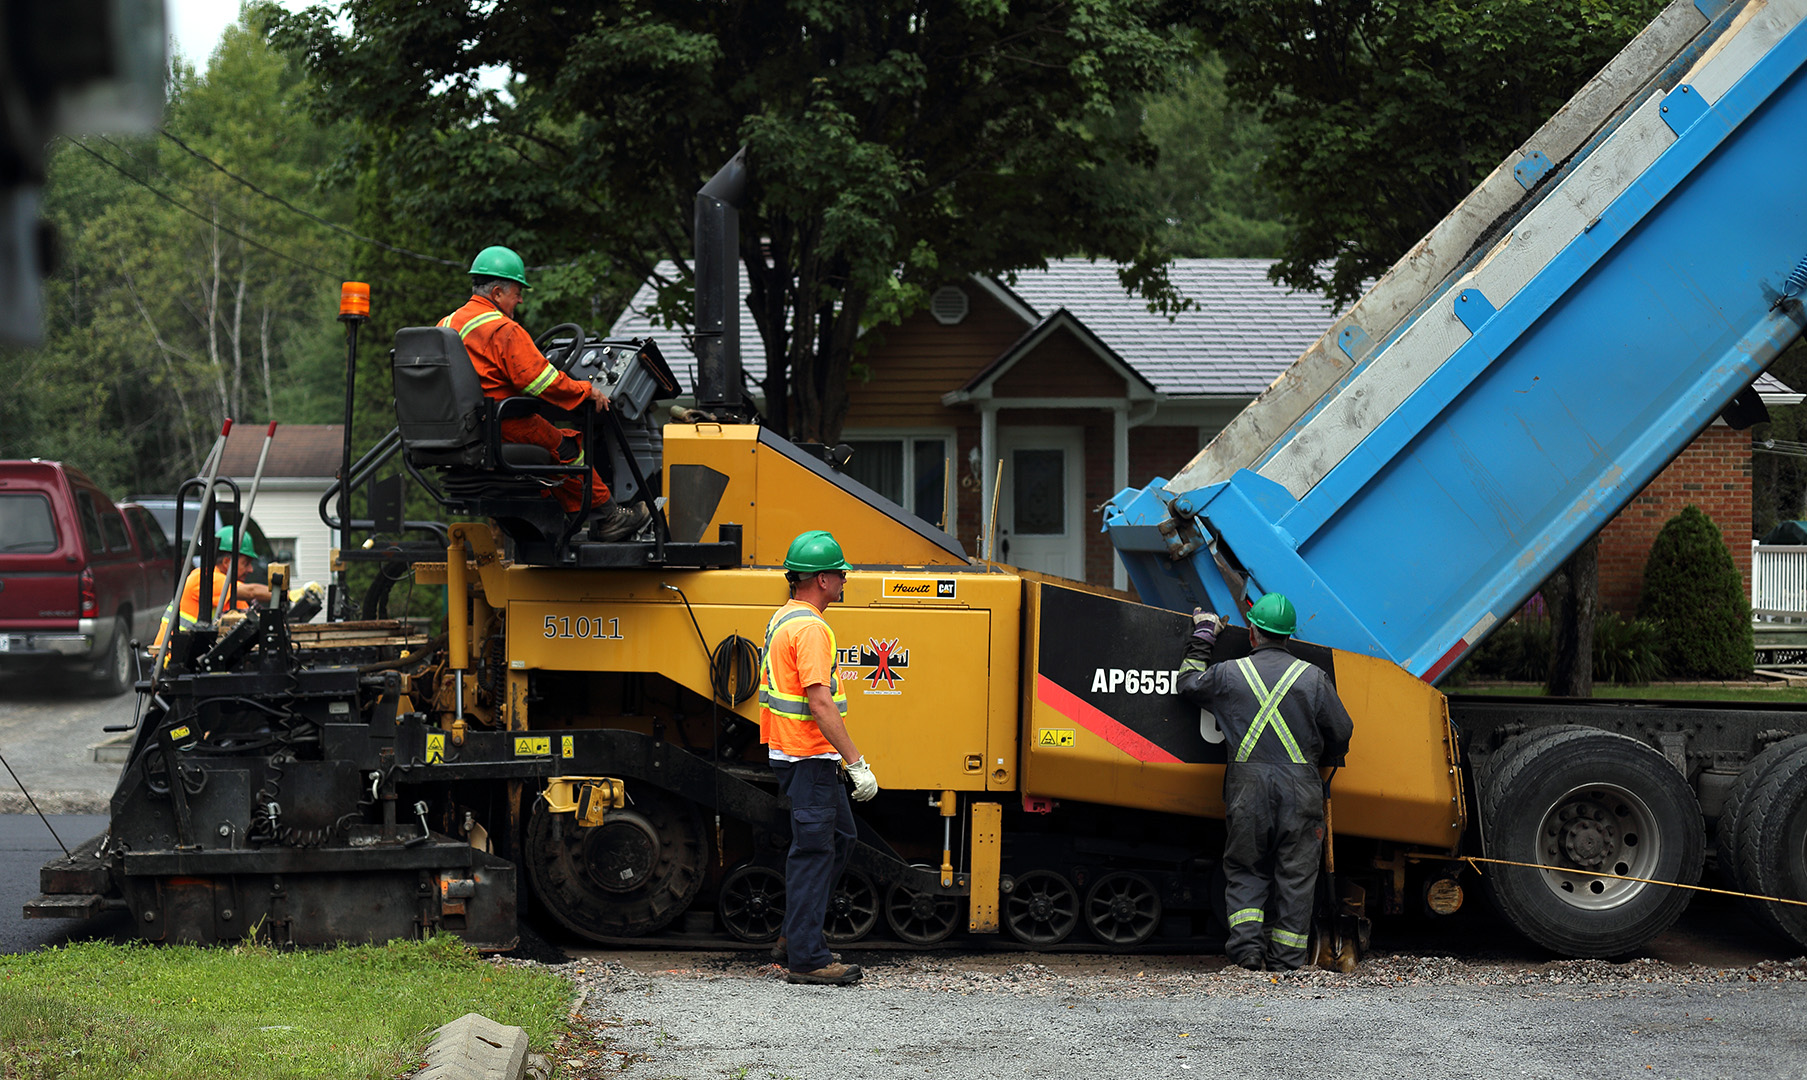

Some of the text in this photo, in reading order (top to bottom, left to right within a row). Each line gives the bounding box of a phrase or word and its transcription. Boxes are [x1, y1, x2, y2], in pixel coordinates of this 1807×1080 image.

[893, 583, 954, 594] Hewitt CAT
[543, 615, 624, 640] 51011
